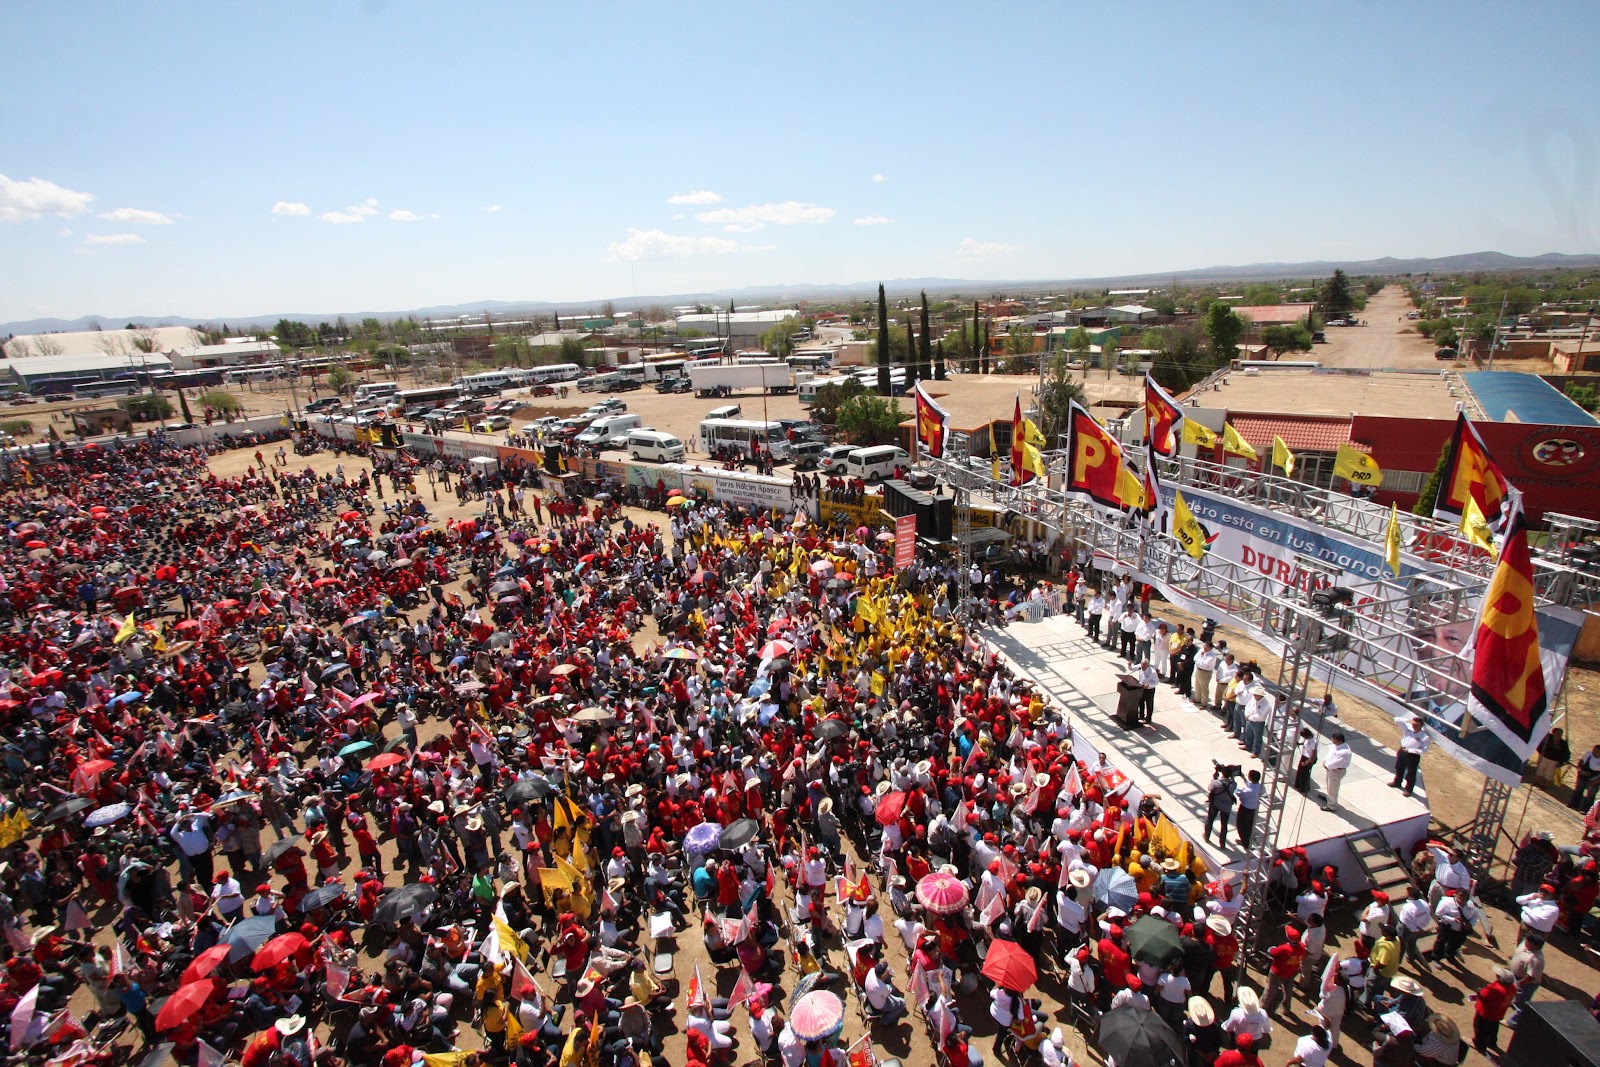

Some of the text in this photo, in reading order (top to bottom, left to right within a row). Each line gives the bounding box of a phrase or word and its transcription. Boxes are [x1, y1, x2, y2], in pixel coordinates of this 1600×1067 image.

[1350, 470, 1372, 481] PRD
[716, 478, 734, 488] Fuerza
[1177, 527, 1194, 545] PRD
[1221, 513, 1254, 531] está
[1259, 526, 1281, 541] en
[1287, 532, 1314, 553] tus
[1317, 546, 1393, 581] manos
